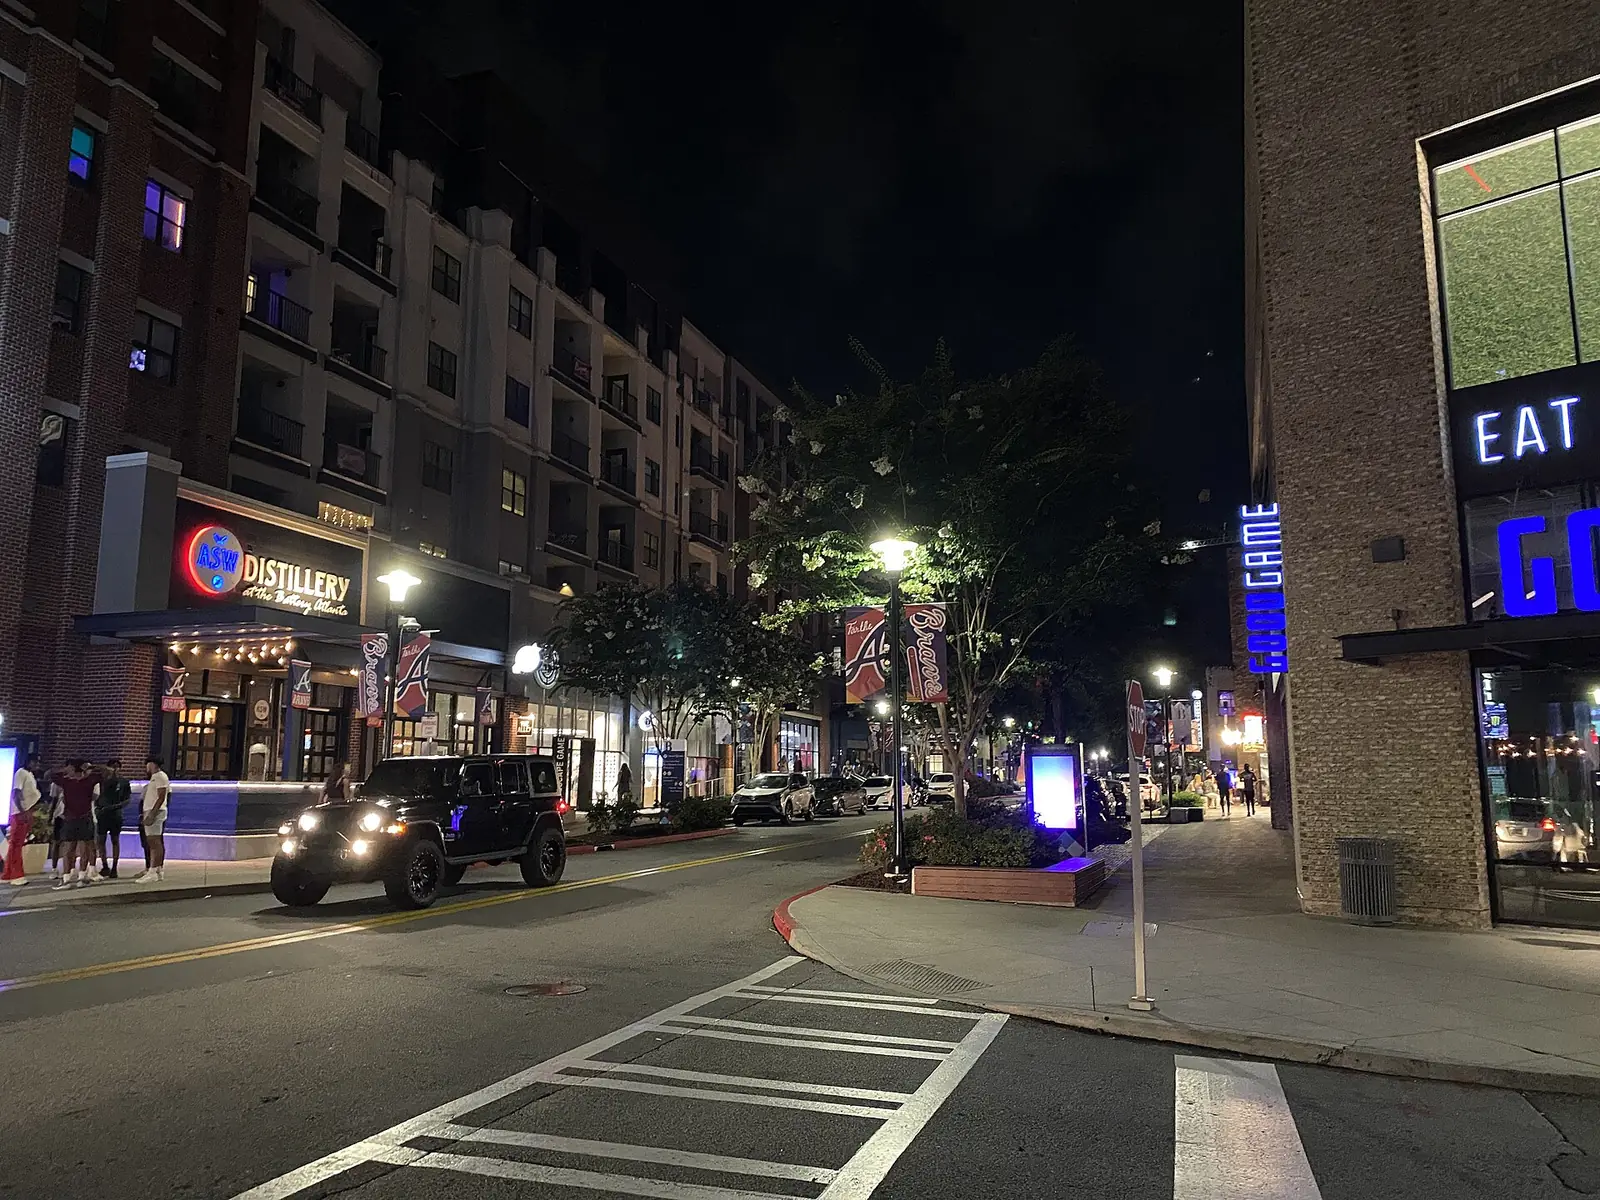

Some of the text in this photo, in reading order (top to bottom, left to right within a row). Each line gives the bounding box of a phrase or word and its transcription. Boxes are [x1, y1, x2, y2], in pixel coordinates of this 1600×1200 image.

[1476, 397, 1581, 463] EAT
[196, 542, 240, 574] ASW
[243, 553, 351, 602] DISTILLERY
[243, 586, 349, 616] at the Battery Atlanta
[1241, 502, 1289, 673] GOOD GAME
[1129, 703, 1145, 735] STOP
